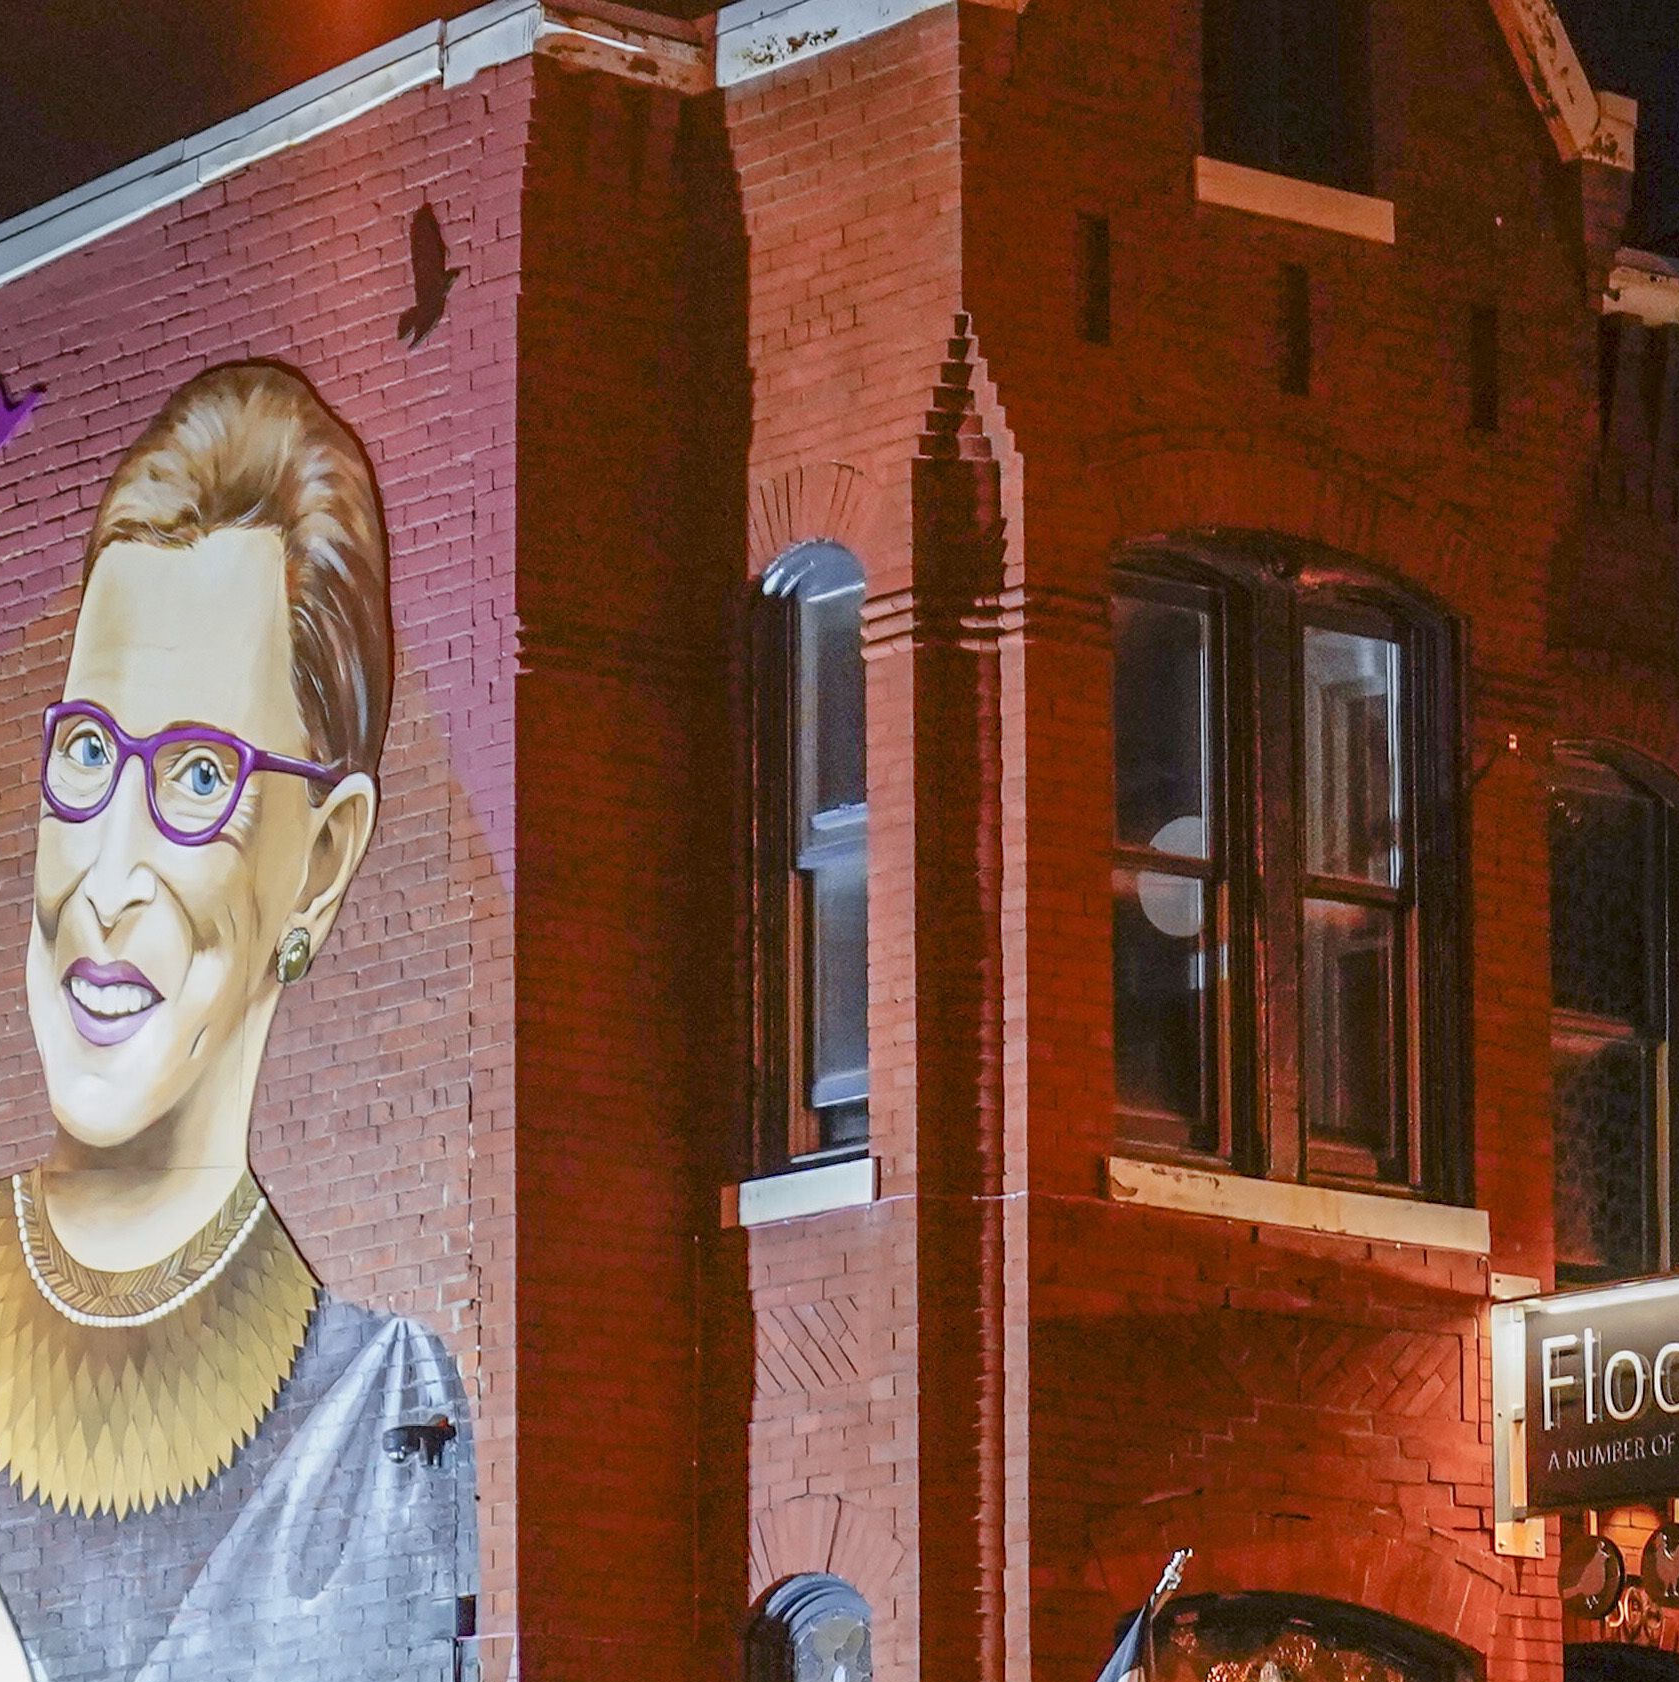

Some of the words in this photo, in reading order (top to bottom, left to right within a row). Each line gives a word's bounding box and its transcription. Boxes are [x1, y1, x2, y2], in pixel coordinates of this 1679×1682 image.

[1548, 1450, 1561, 1472] A
[1567, 1437, 1646, 1470] NUMBER
[1651, 1431, 1676, 1458] OF
